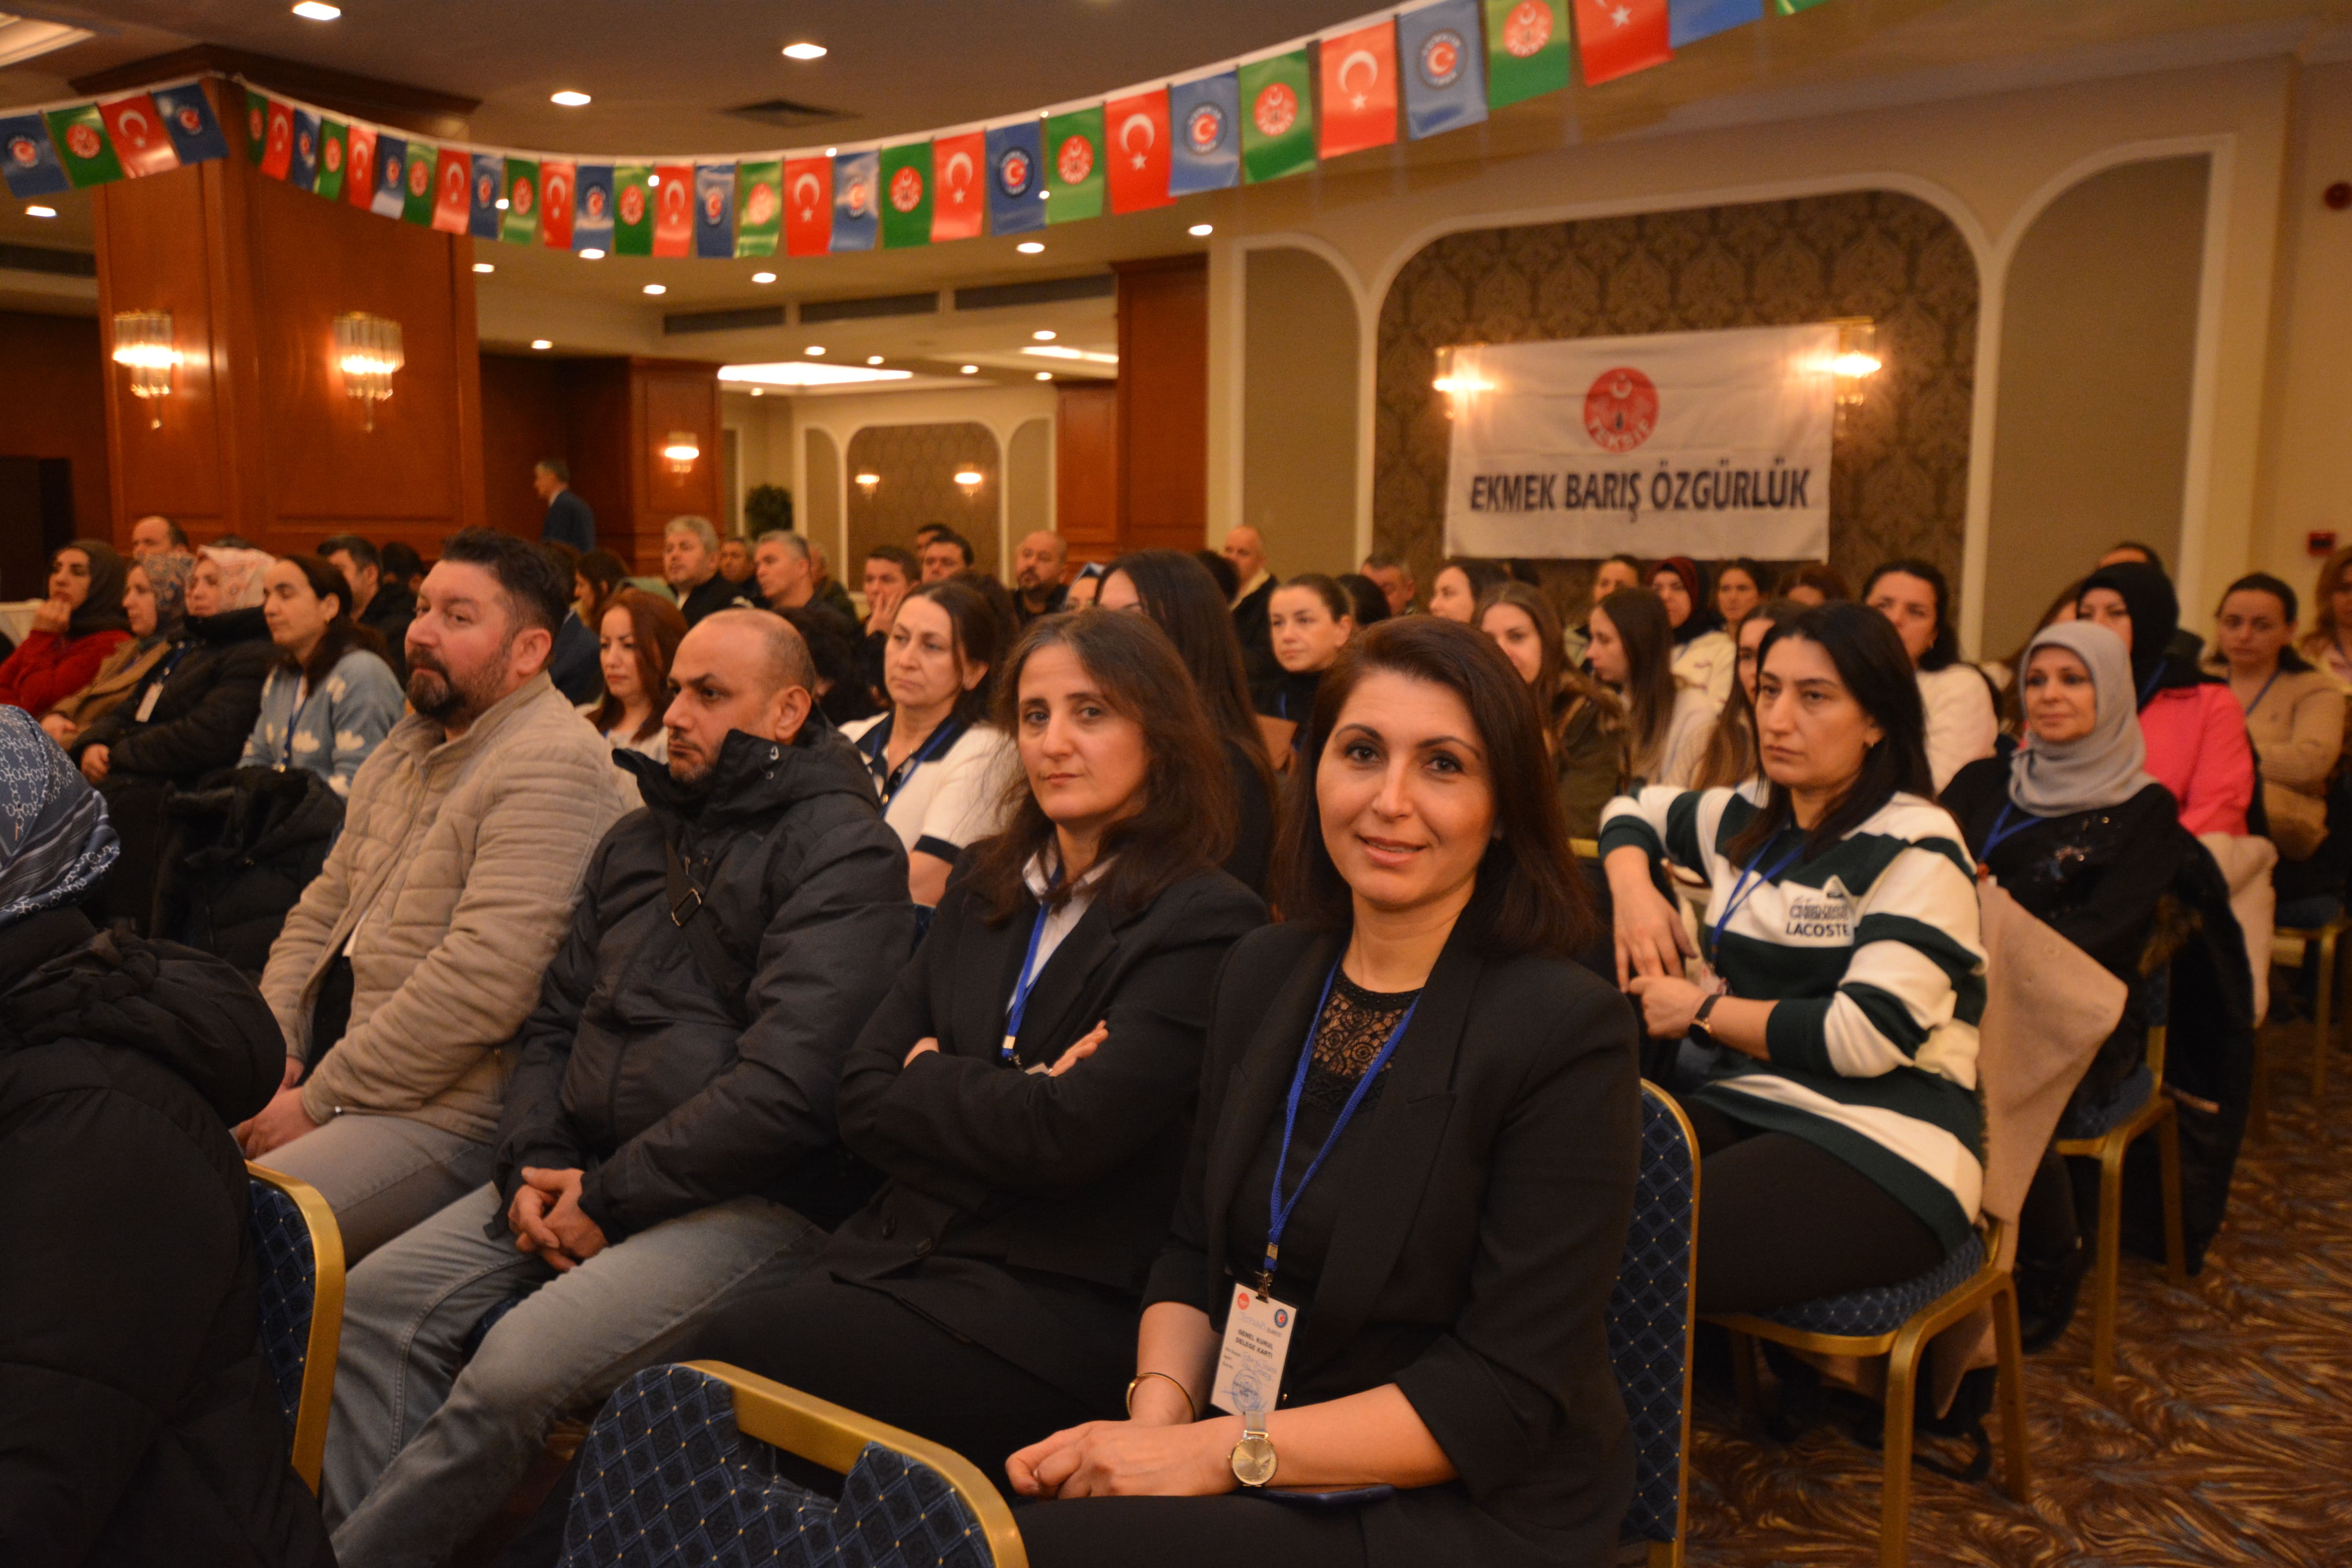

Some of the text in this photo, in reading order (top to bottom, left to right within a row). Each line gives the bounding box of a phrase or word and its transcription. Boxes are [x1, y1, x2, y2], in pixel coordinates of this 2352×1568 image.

[1469, 457, 1812, 523] EKMEK BARIŞ ÖZGÜRLÜK
[1786, 921, 1850, 936] LACOSTE
[1235, 1337, 1273, 1358] DELEGE KARTI
[1238, 1329, 1273, 1349] GENEL KURUL
